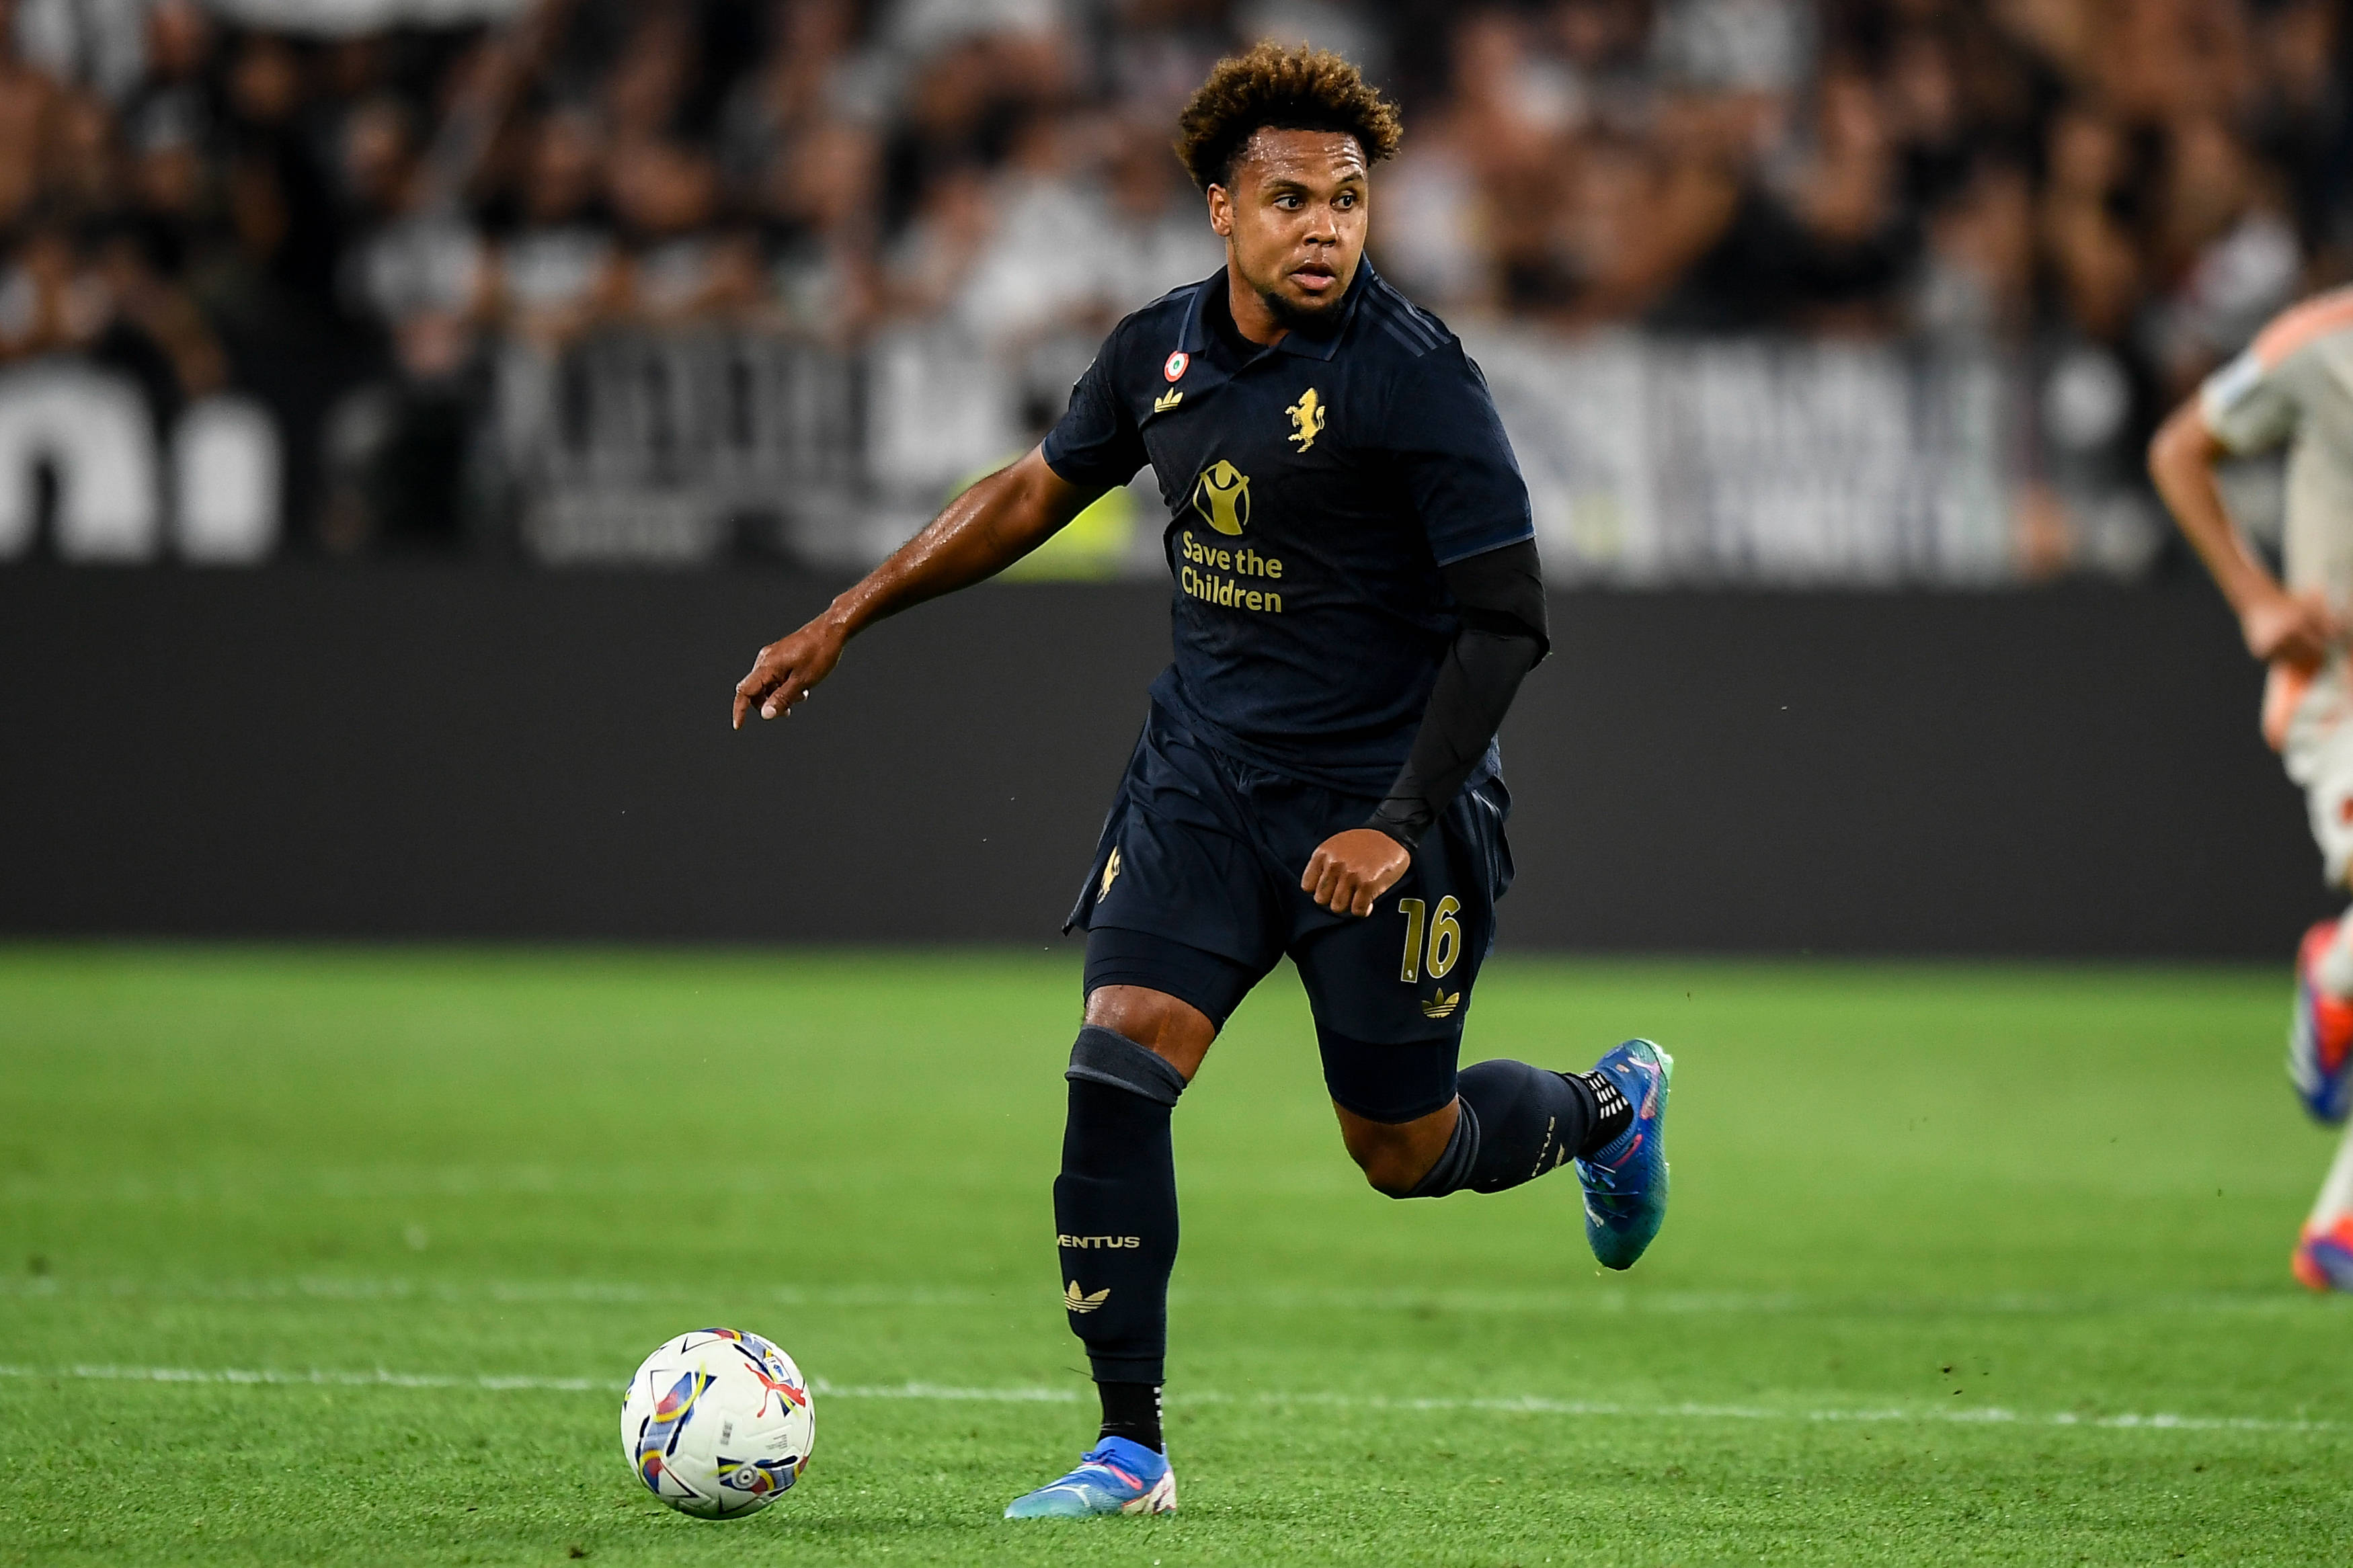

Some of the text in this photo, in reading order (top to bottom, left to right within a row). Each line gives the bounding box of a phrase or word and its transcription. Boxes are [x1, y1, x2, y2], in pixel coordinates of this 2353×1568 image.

[1183, 531, 1282, 578] Save the
[1182, 566, 1281, 612] Children
[1398, 895, 1461, 983] 16
